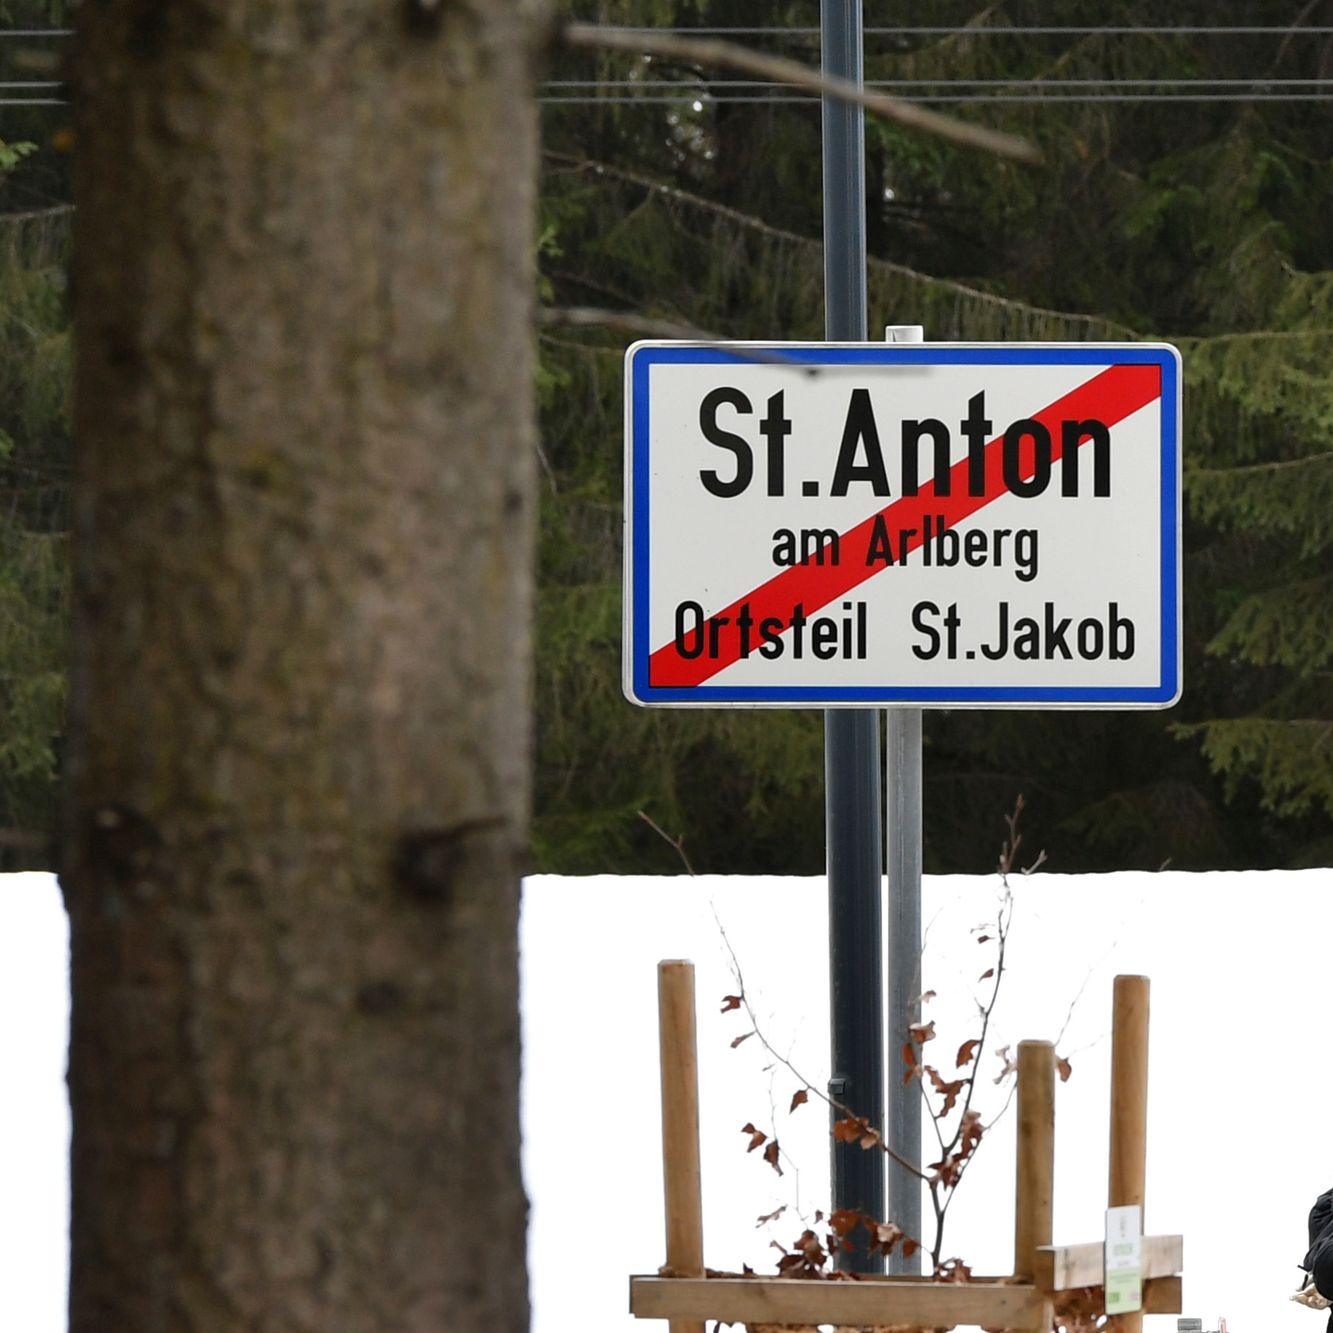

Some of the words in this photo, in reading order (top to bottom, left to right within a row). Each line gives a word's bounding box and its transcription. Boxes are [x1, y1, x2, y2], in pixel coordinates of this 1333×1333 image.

[699, 386, 1111, 499] St.Anton
[772, 528, 840, 567] am
[866, 515, 1039, 582] Arlberg
[675, 601, 868, 660] Ortsteil
[911, 602, 1135, 660] St.Jakob
